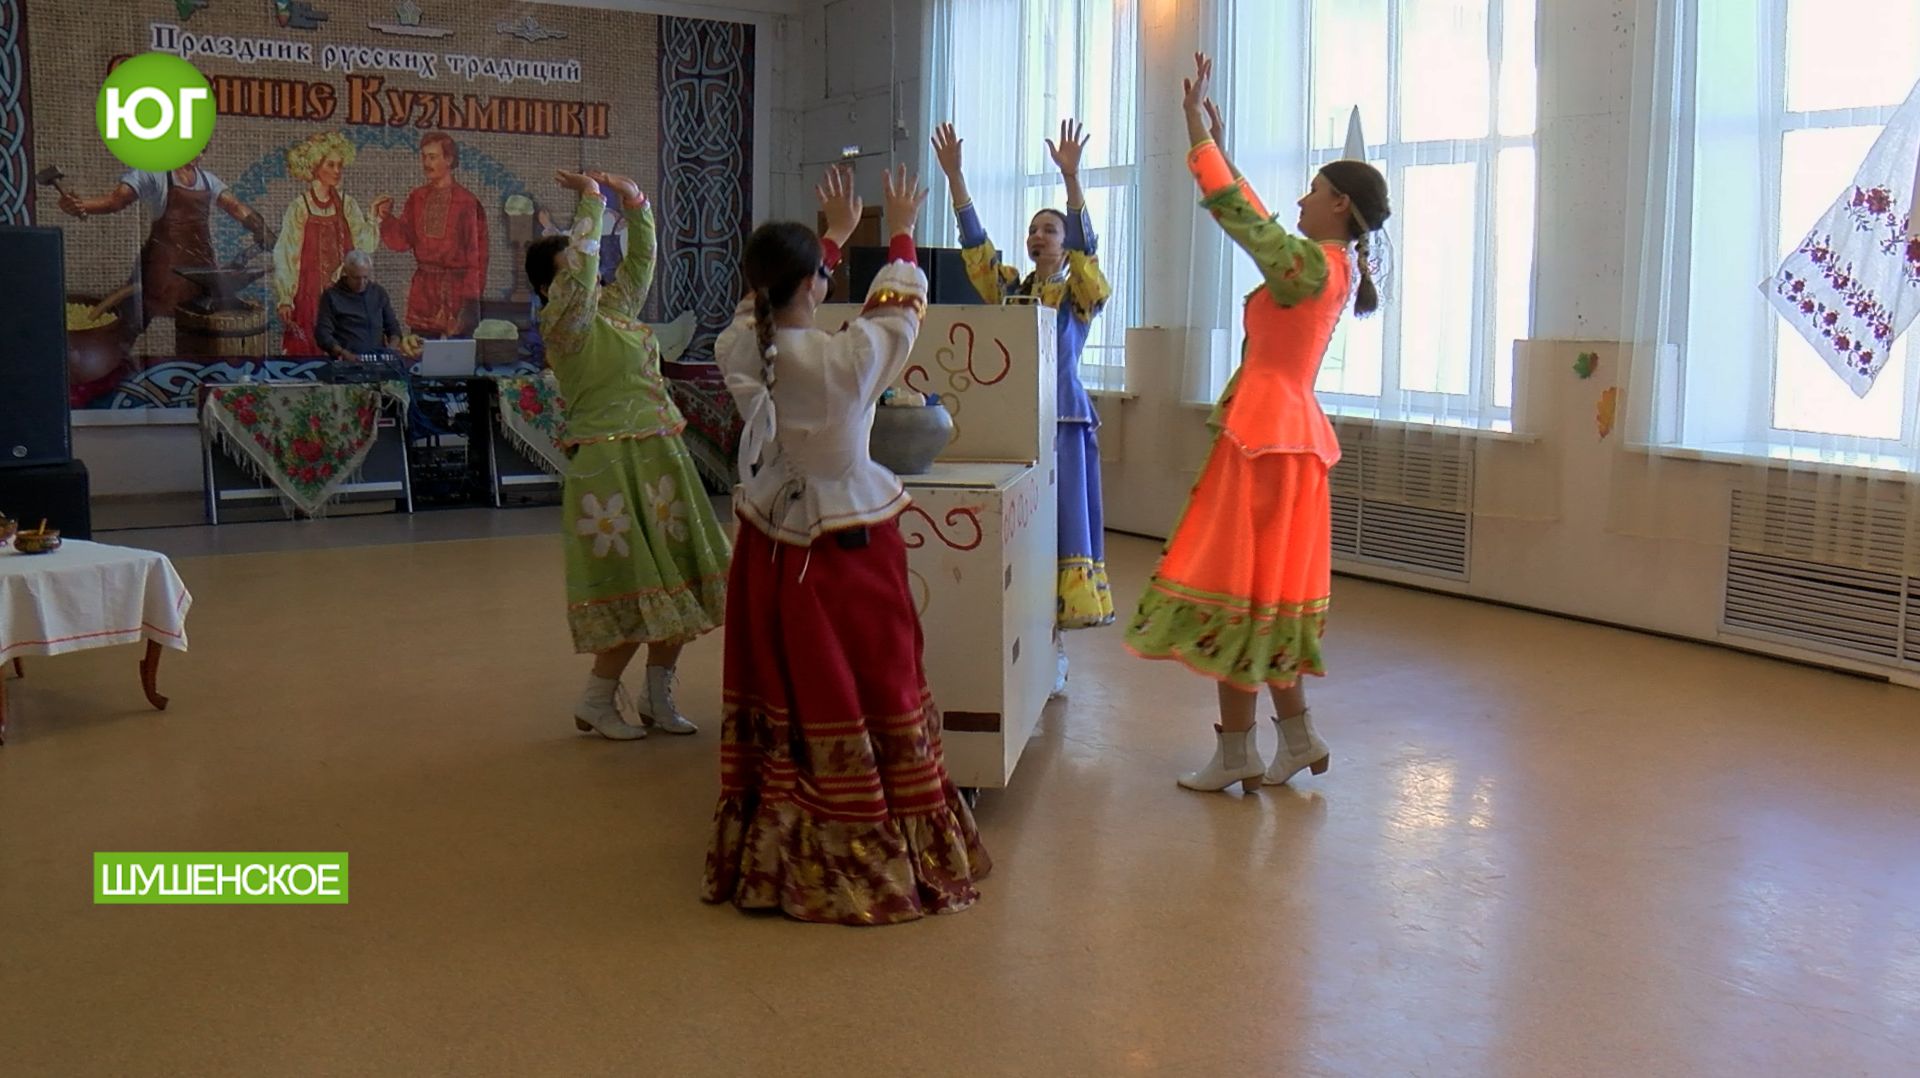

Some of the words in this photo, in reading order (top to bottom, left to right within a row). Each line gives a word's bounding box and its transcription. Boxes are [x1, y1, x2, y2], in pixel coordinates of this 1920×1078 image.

[152, 24, 311, 61] Праздник
[324, 46, 436, 76] русских
[447, 57, 581, 82] традиций
